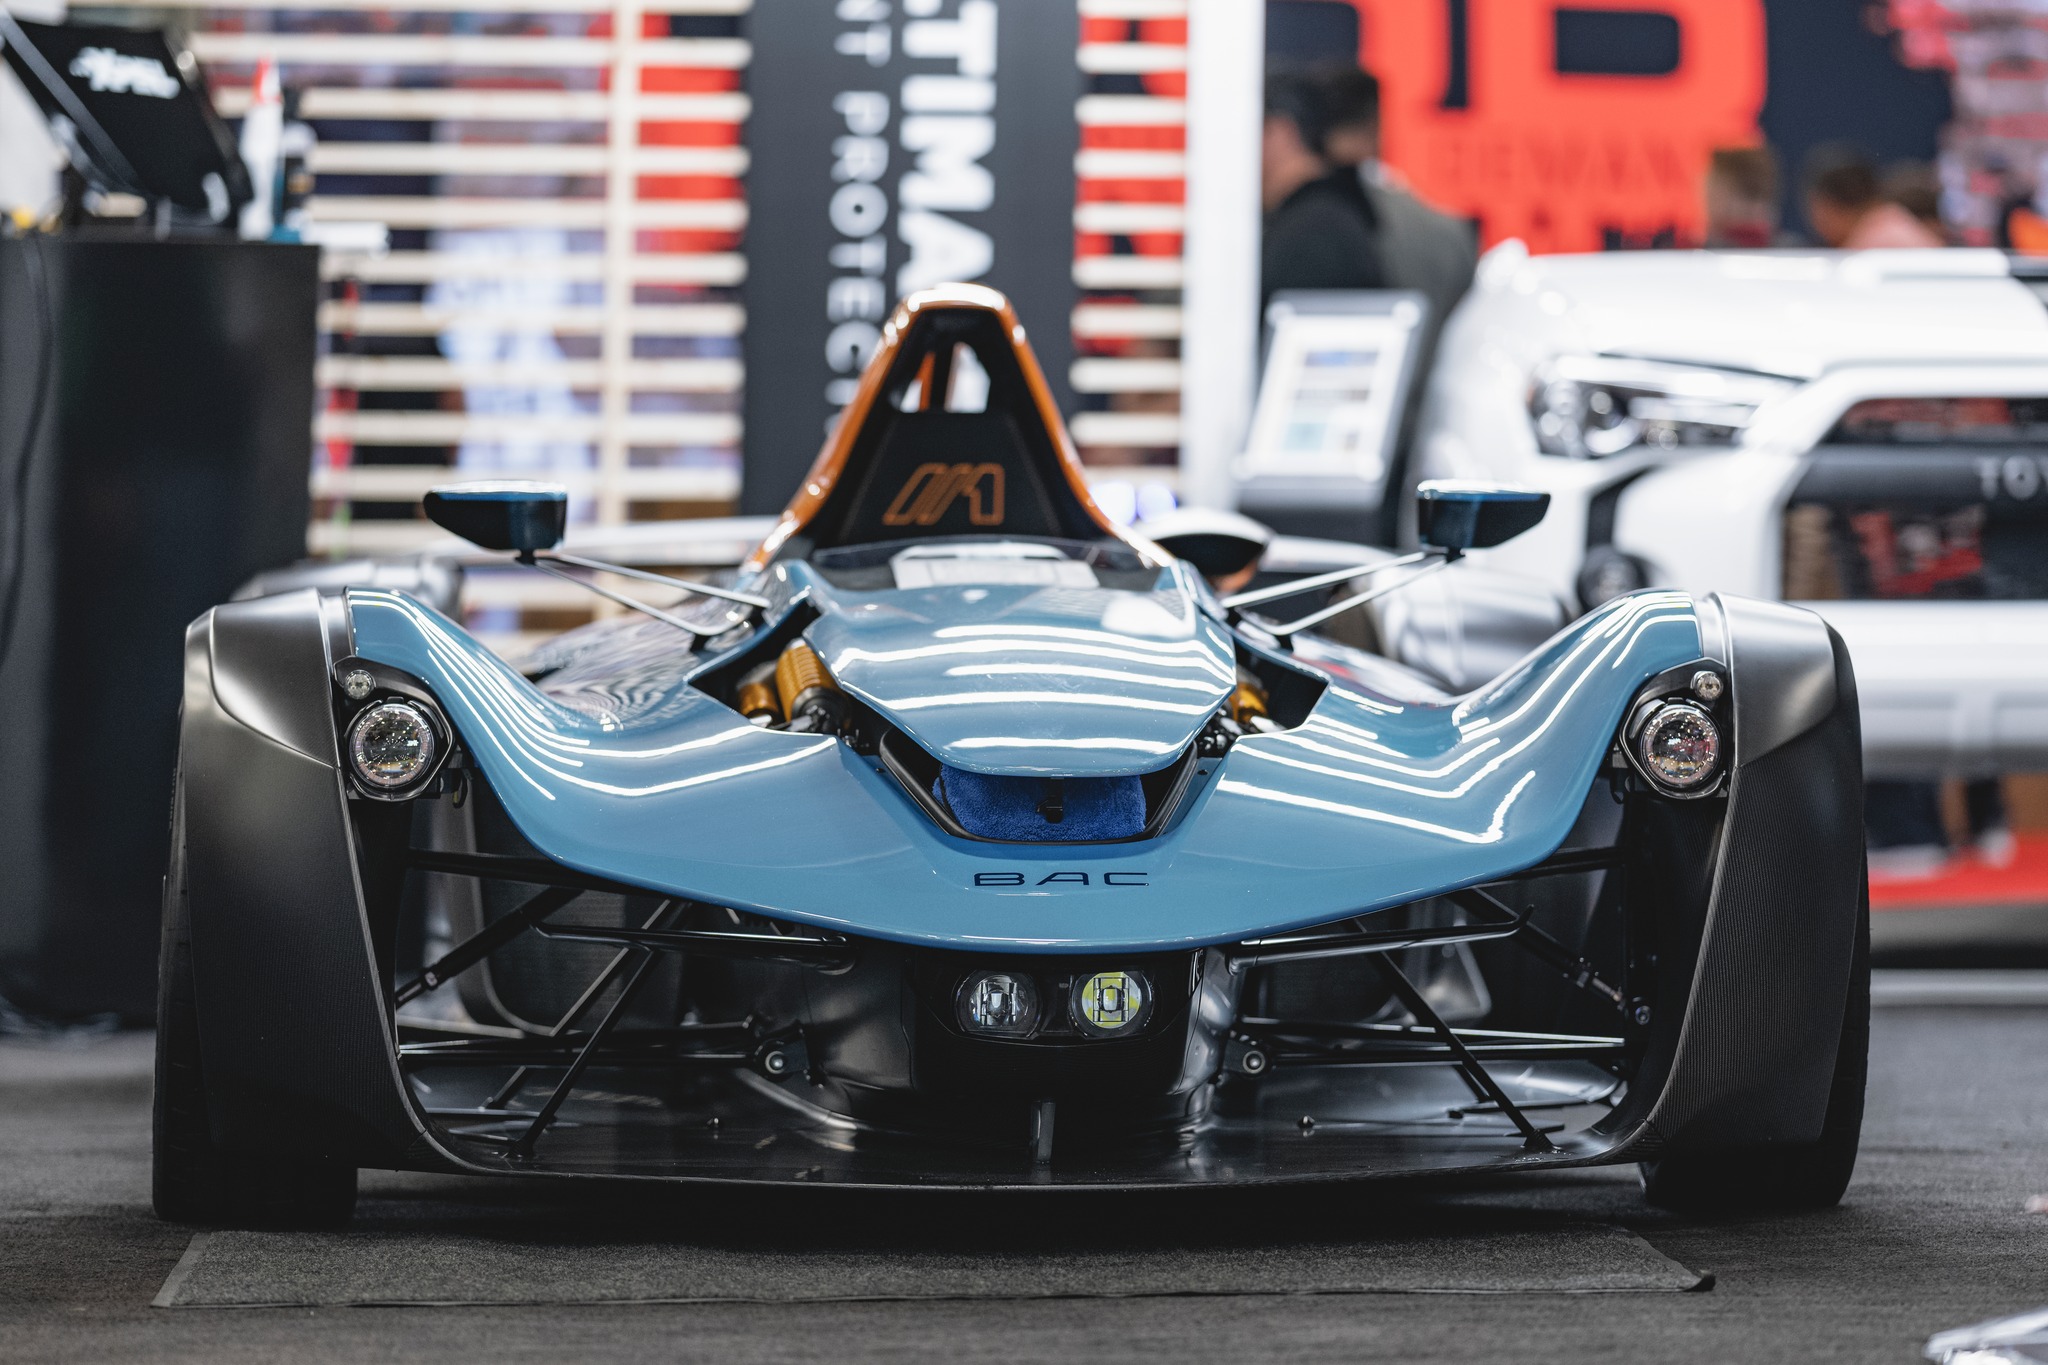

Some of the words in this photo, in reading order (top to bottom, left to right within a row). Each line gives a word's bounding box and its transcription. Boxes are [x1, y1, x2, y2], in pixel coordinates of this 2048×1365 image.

[897, 0, 998, 300] TIMA
[824, 90, 890, 437] PROTEC
[1973, 455, 2048, 500] TO
[973, 871, 1150, 887] BAC
